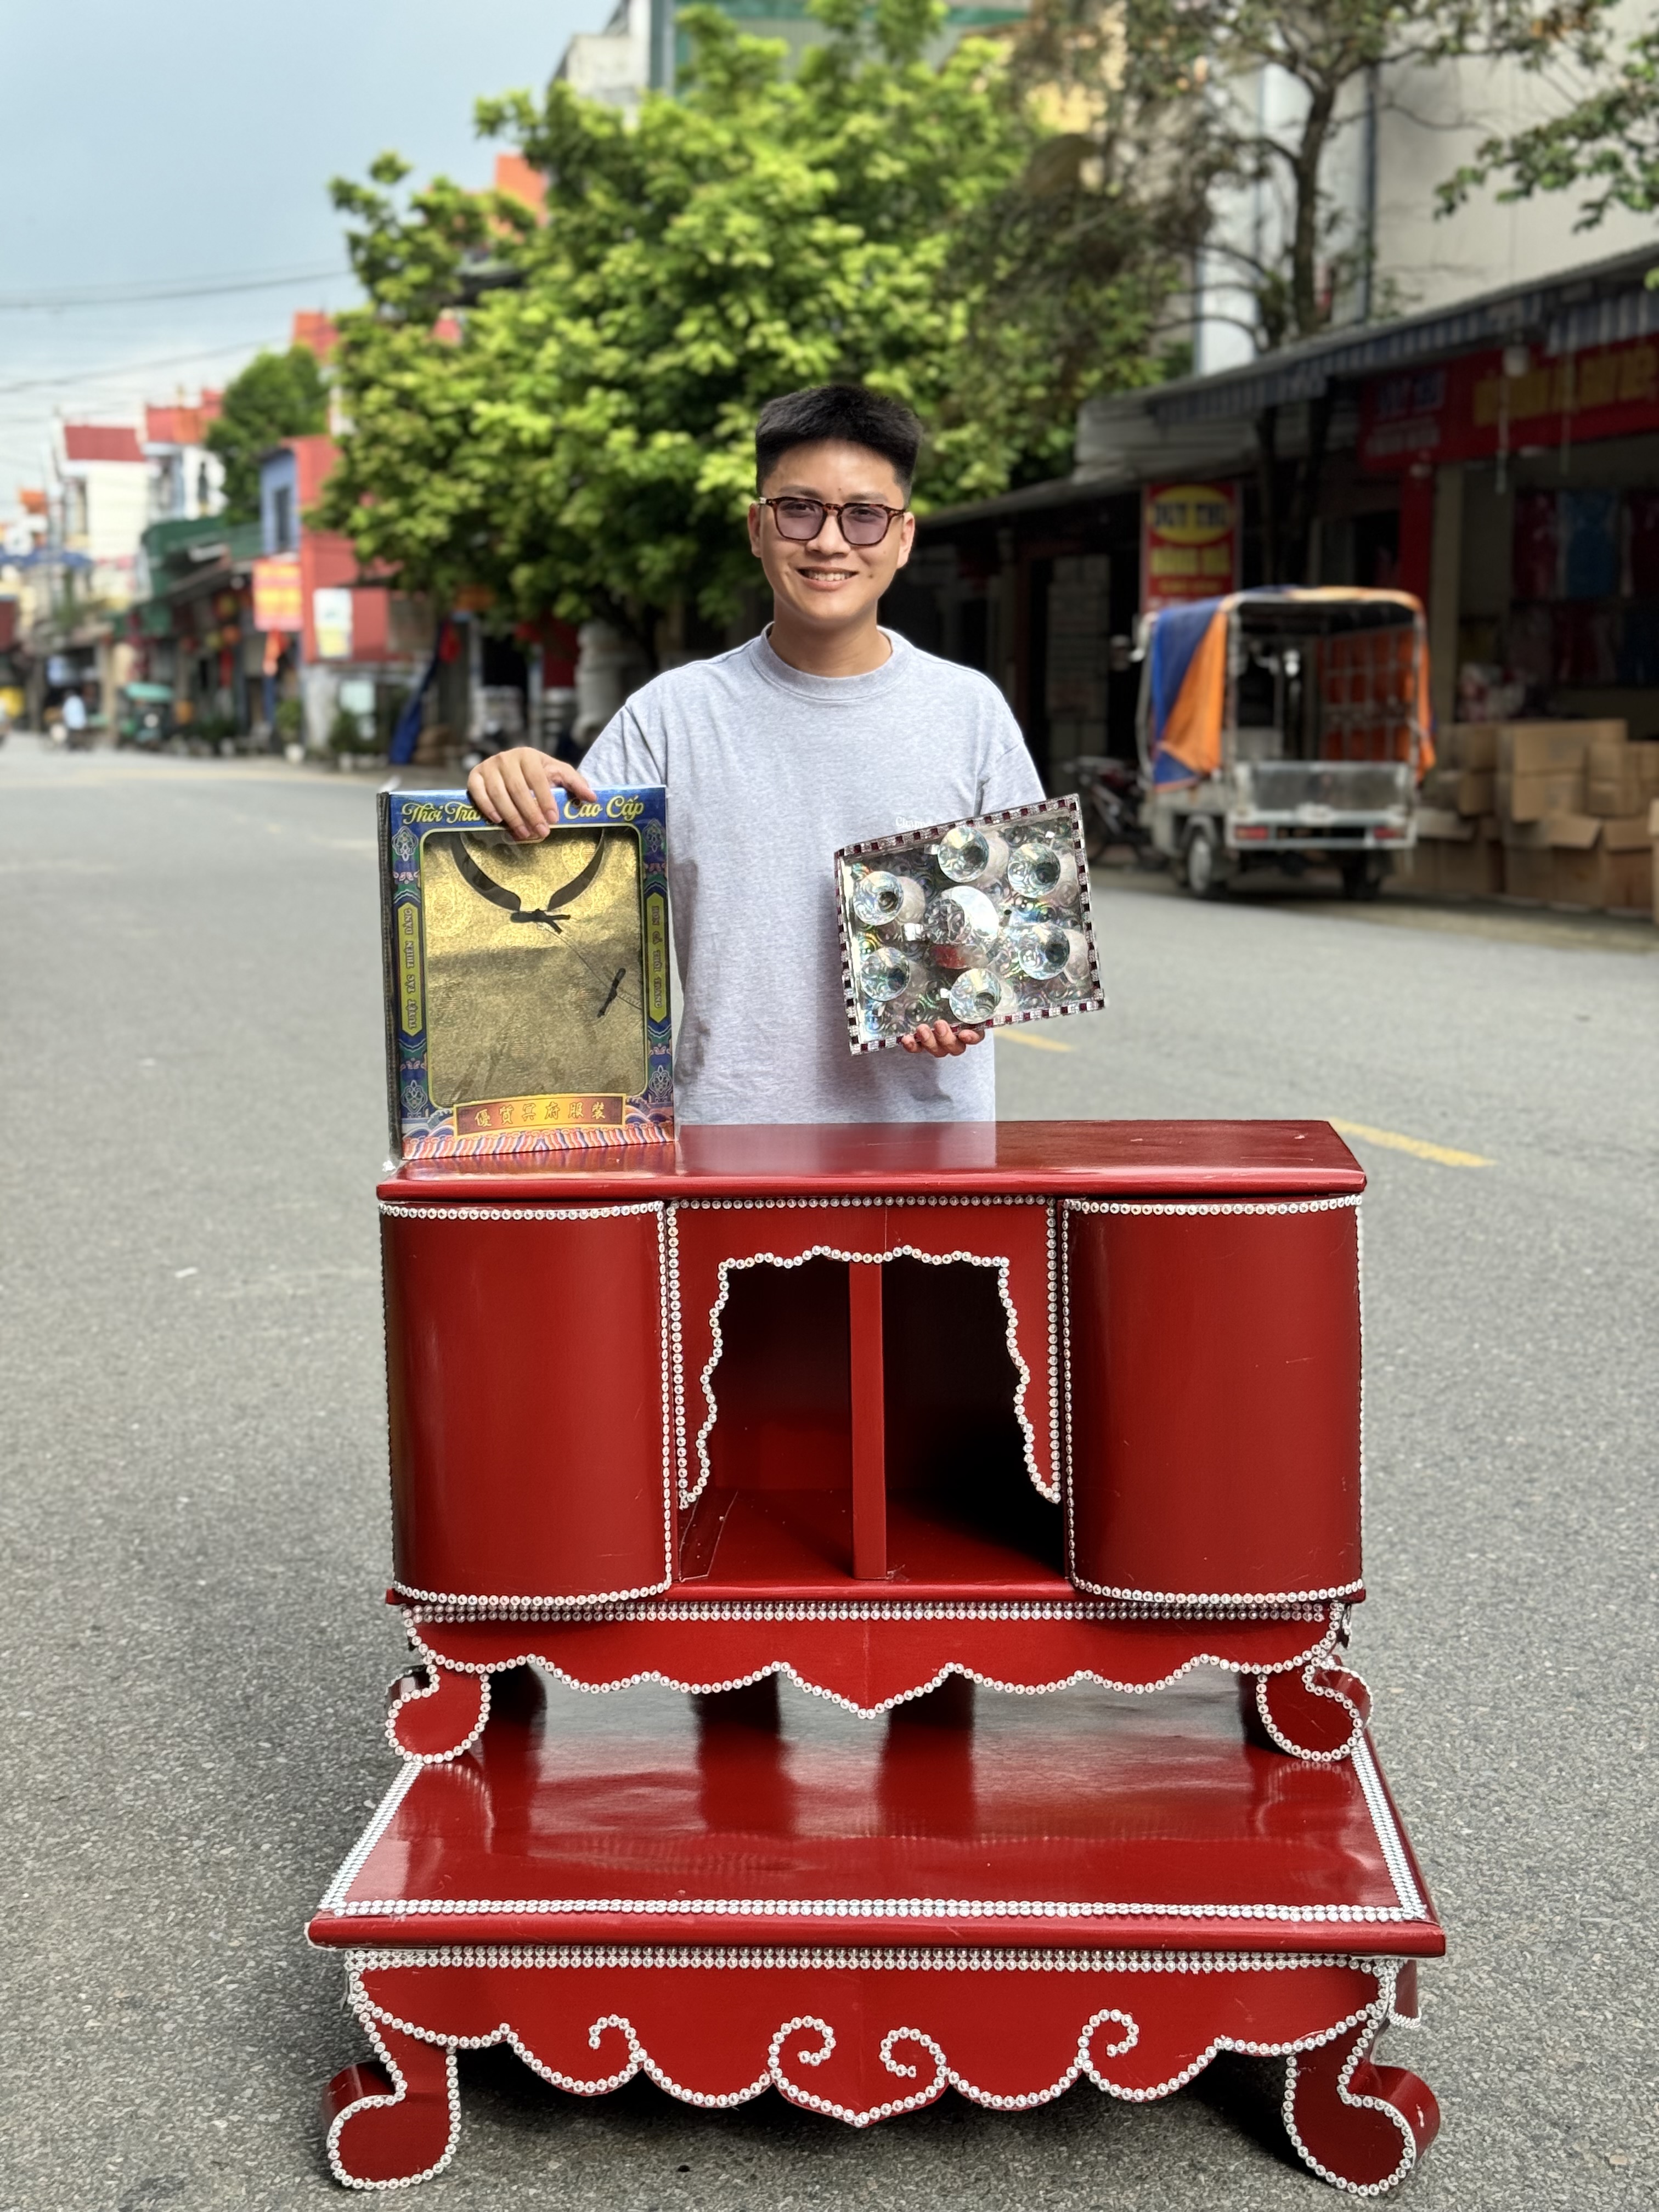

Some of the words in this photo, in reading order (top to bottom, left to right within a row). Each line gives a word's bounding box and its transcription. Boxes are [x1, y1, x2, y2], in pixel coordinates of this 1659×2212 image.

[444, 801, 494, 825] Tra
[563, 798, 603, 820] Cao
[606, 795, 644, 821] Cấp
